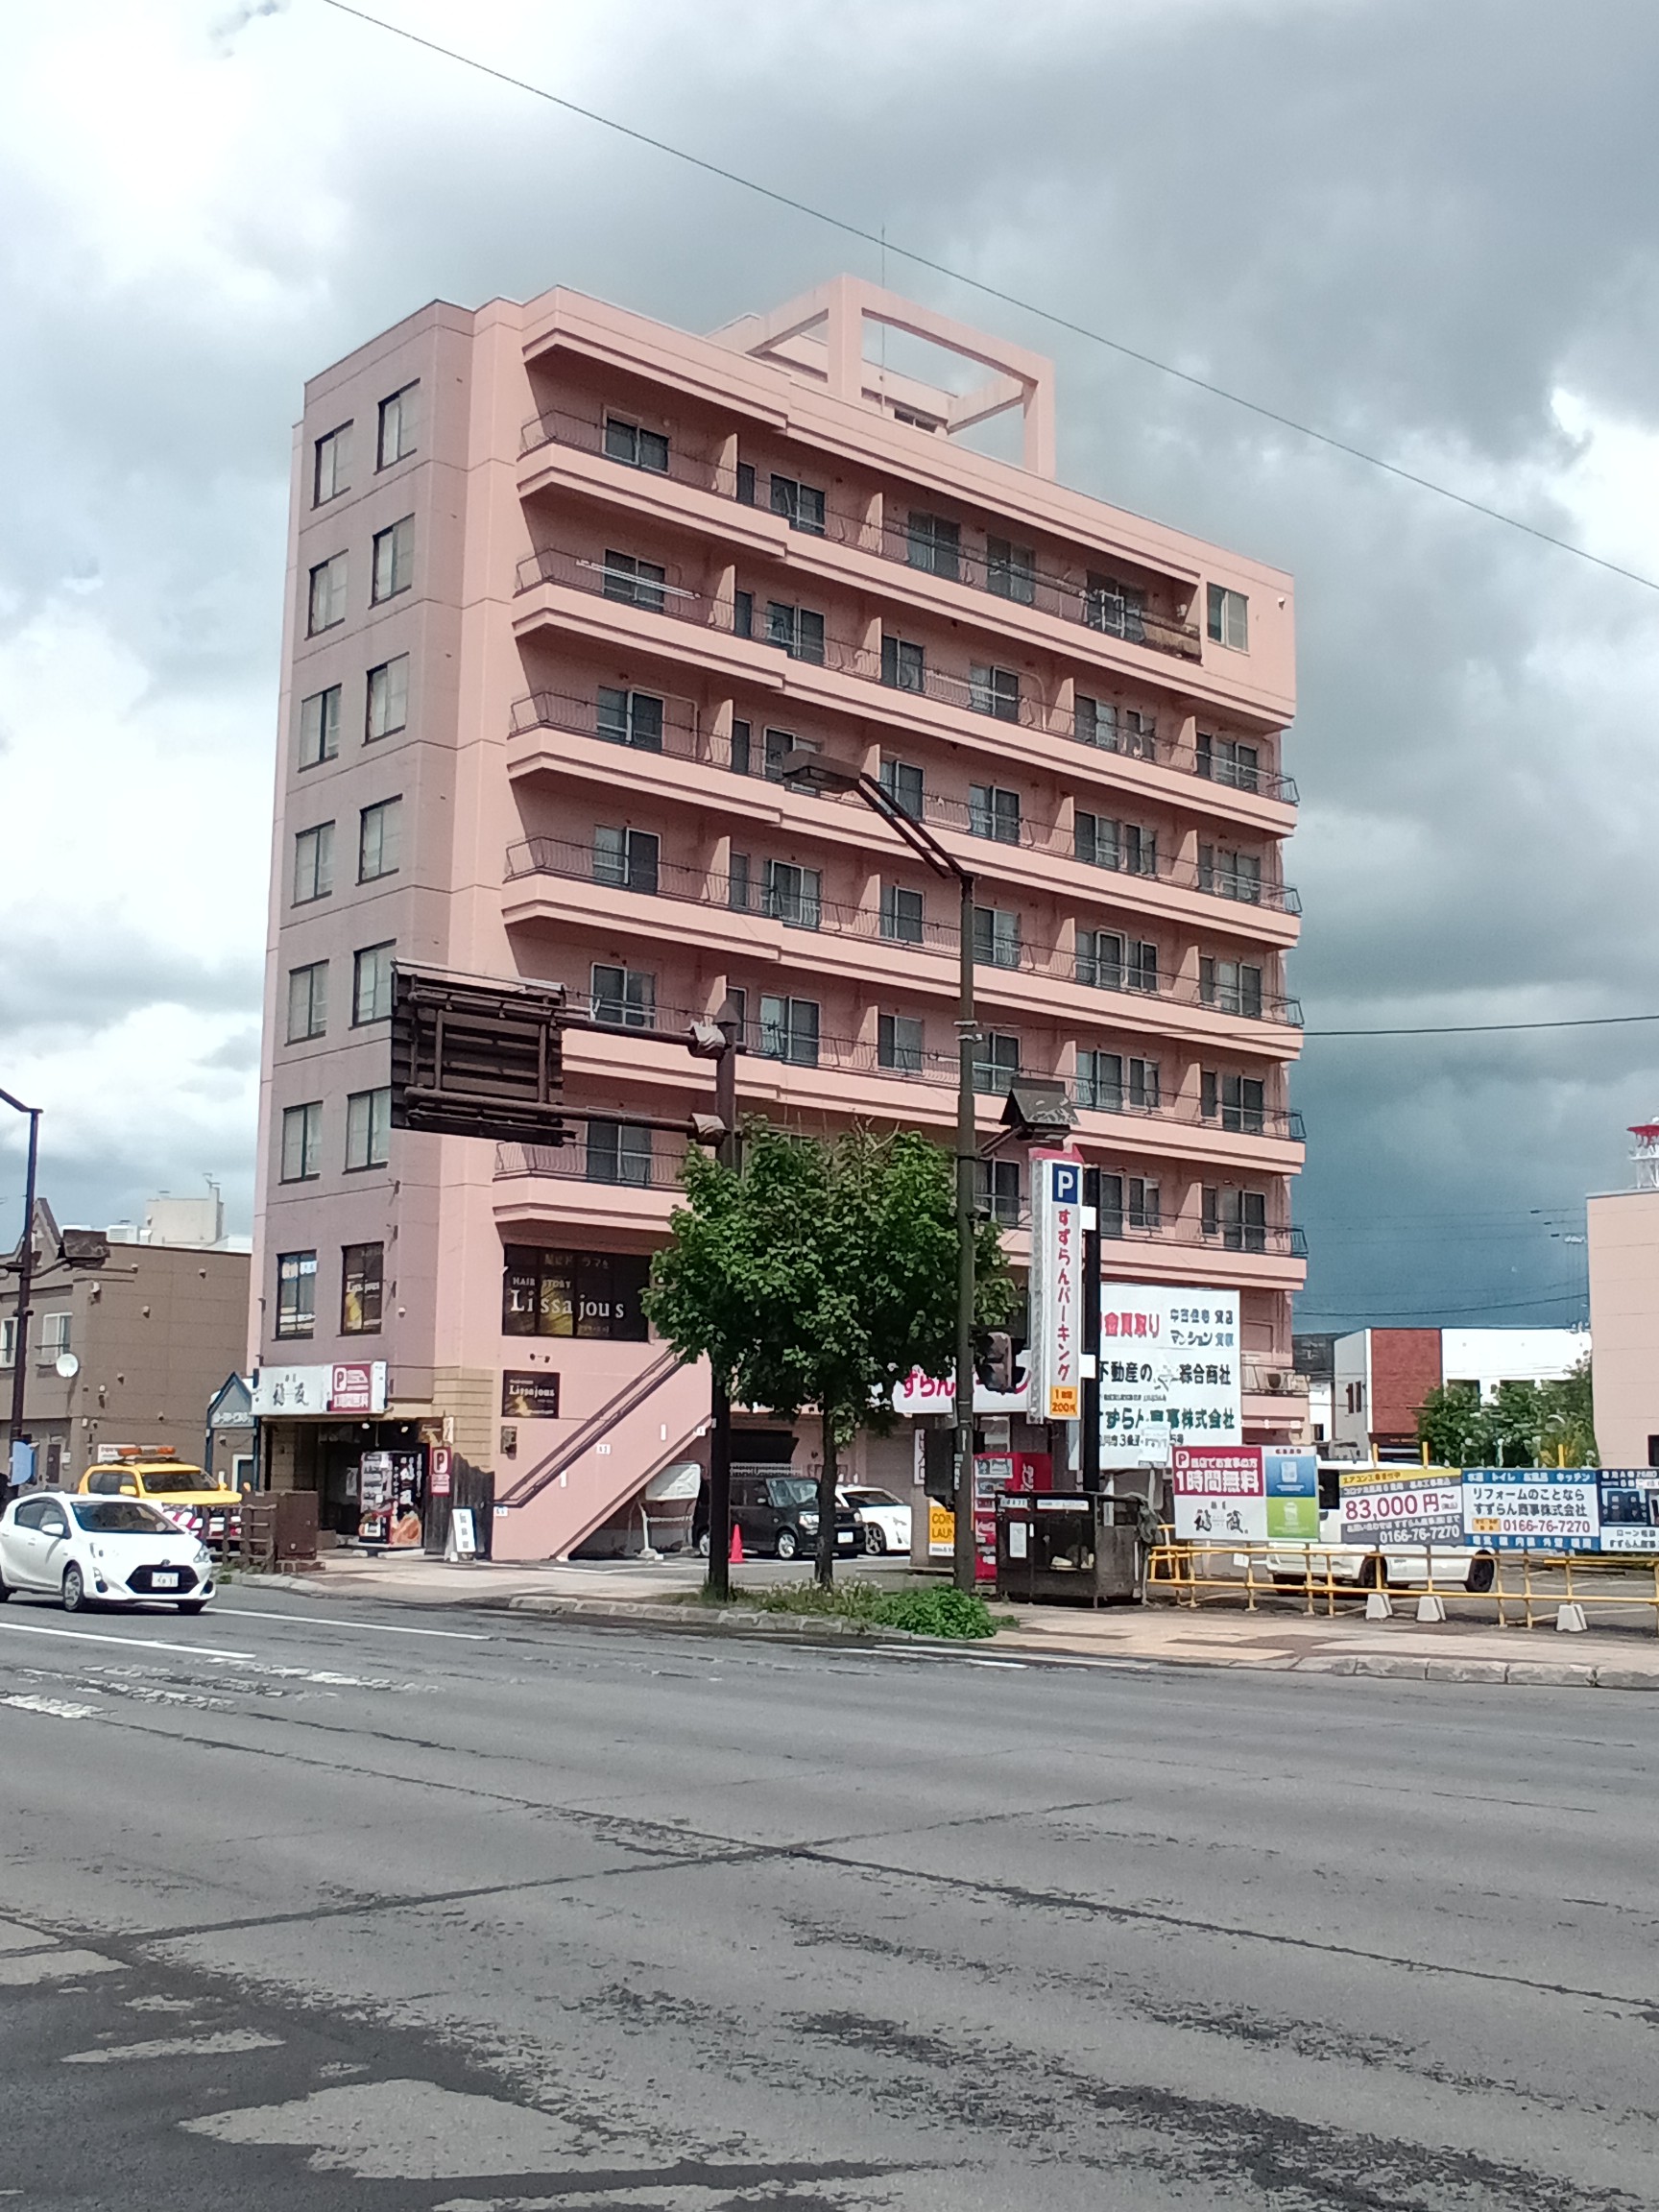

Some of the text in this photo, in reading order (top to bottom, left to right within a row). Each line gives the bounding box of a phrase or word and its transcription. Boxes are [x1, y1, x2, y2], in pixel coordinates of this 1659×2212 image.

[1057, 1170, 1073, 1198] P
[513, 1277, 536, 1286] HAIR
[1057, 1209, 1070, 1382] すずらんパーキング
[1099, 1407, 1236, 1431] ずらん商事株式会社
[1176, 1469, 1260, 1493] 1時間無料
[1556, 1472, 1591, 1482] キッチン
[1473, 1488, 1585, 1501] リフォームのことなら
[1473, 1503, 1588, 1517] すずらん商事株式会社
[1380, 1524, 1460, 1544] 0166-76-7270
[1503, 1519, 1591, 1533] 0166-76-7270
